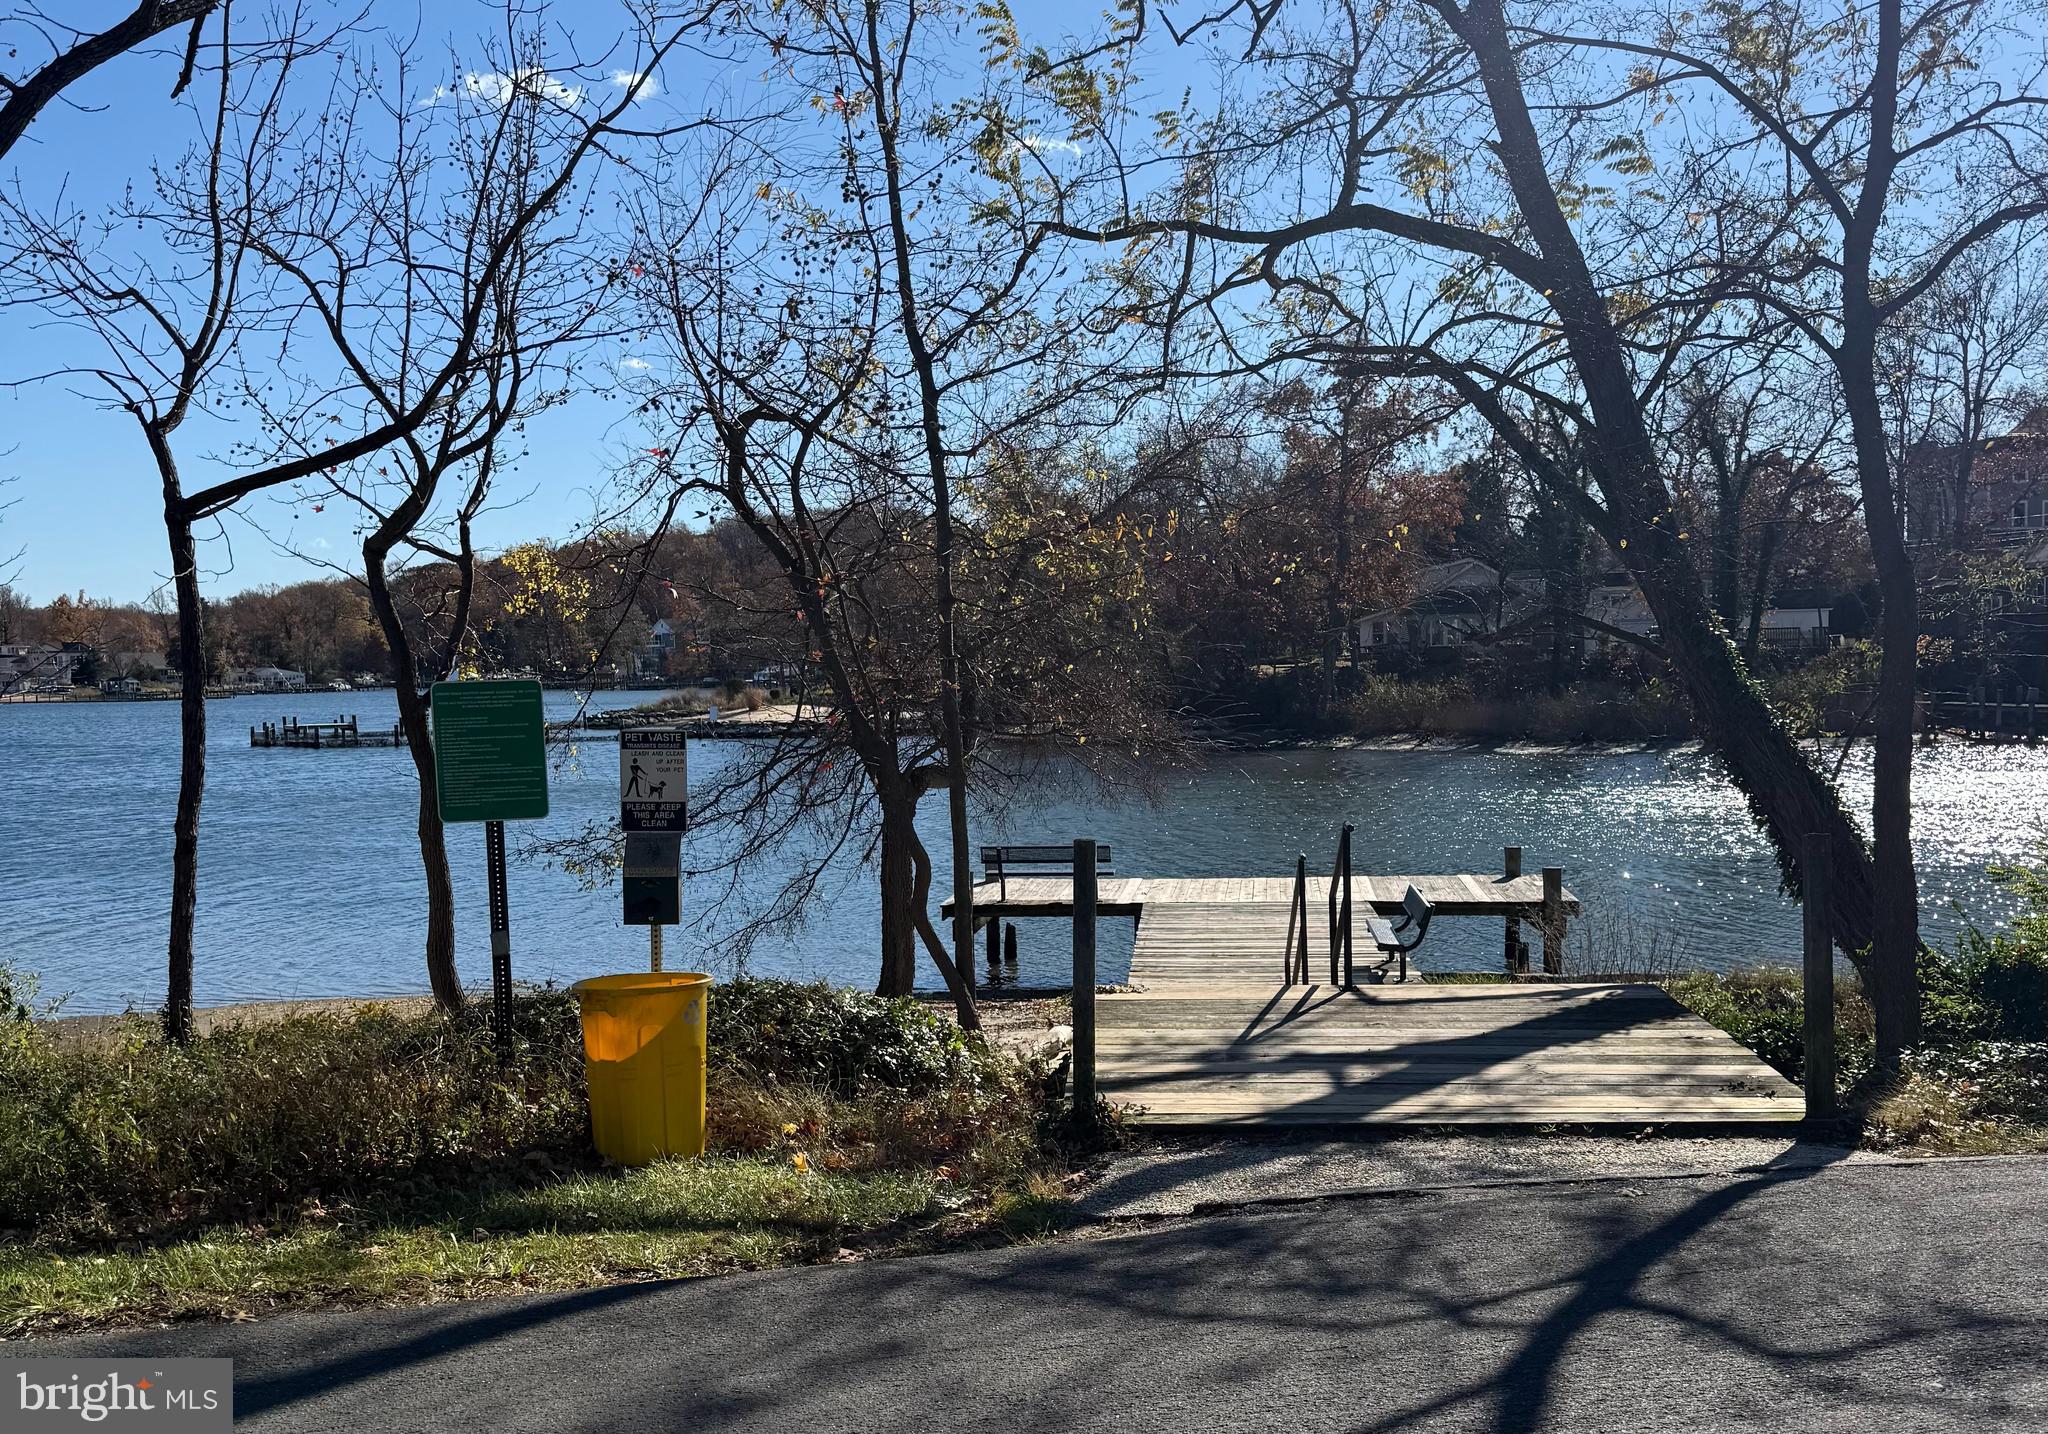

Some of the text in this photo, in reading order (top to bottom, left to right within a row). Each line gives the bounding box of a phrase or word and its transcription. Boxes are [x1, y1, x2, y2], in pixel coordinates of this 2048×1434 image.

[625, 733, 681, 742] PET WASTE
[627, 803, 681, 811] PLEASE KEEP
[633, 811, 675, 819] THIS AREA
[641, 819, 667, 827] CLEAN
